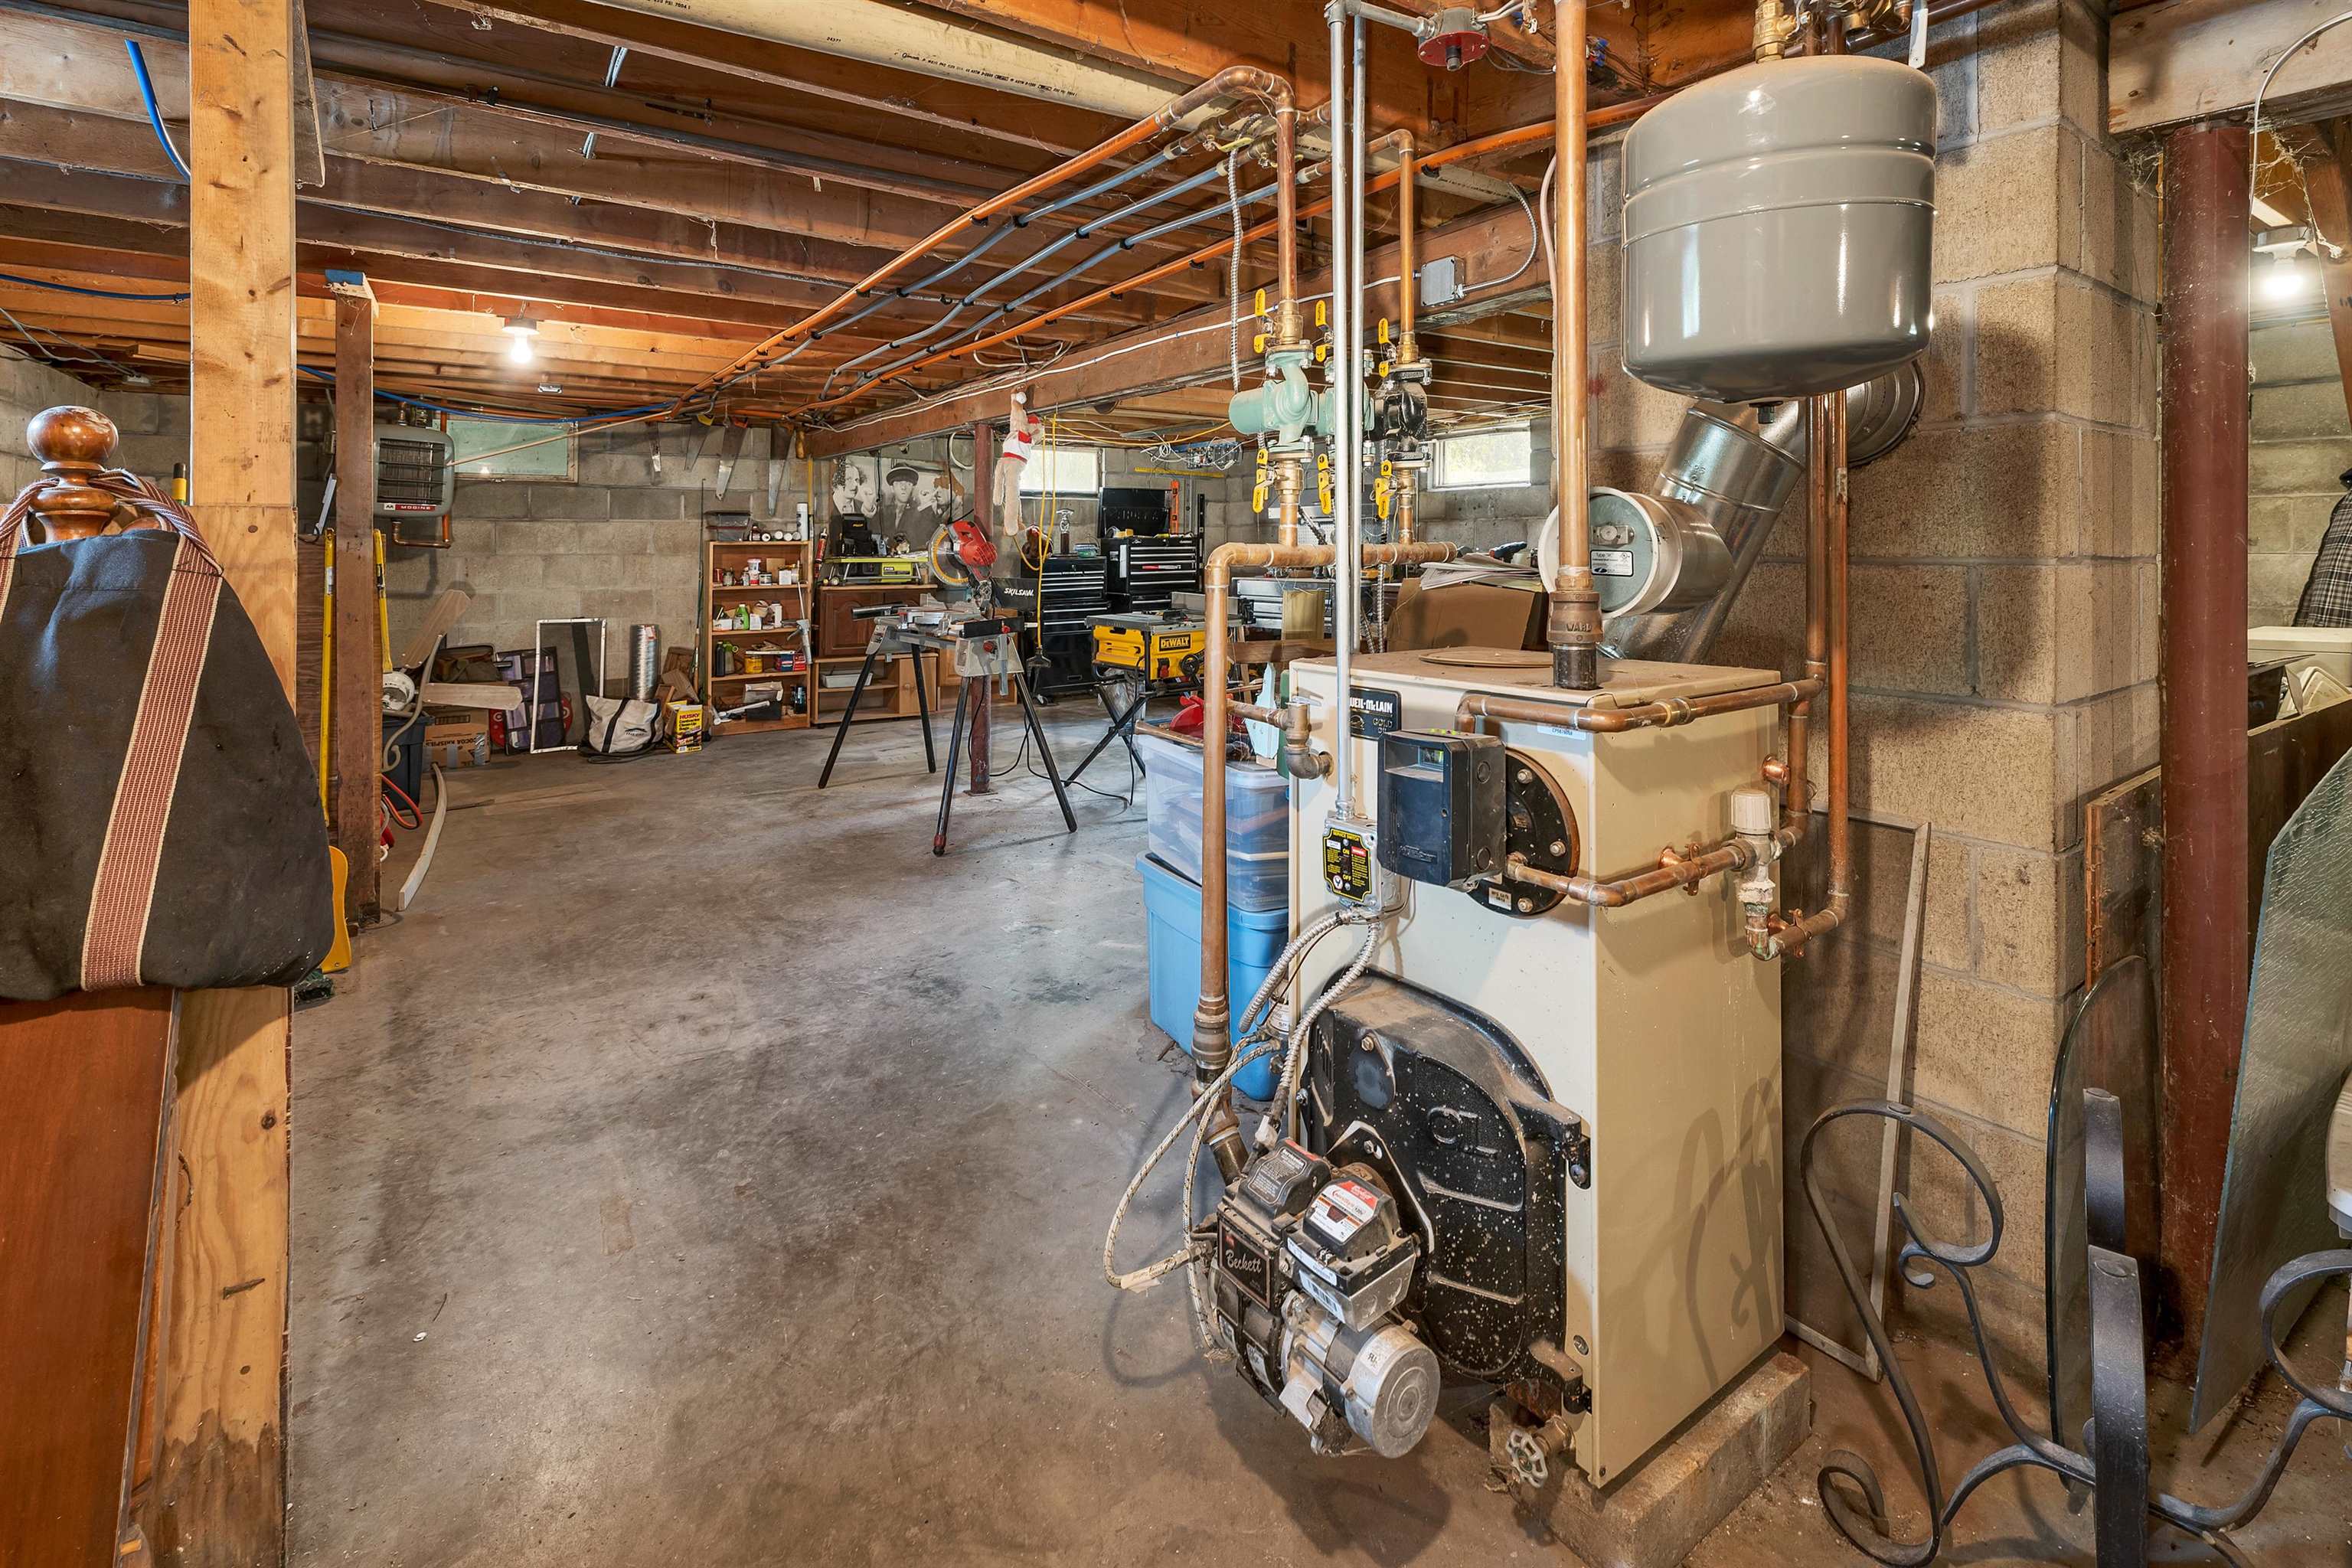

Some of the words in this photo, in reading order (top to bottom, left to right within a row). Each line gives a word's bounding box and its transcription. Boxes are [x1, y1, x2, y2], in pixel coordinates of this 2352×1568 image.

[1004, 587, 1034, 596] SKILSAW
[1566, 622, 1592, 632] WARD
[1225, 1249, 1263, 1274] Beckett
